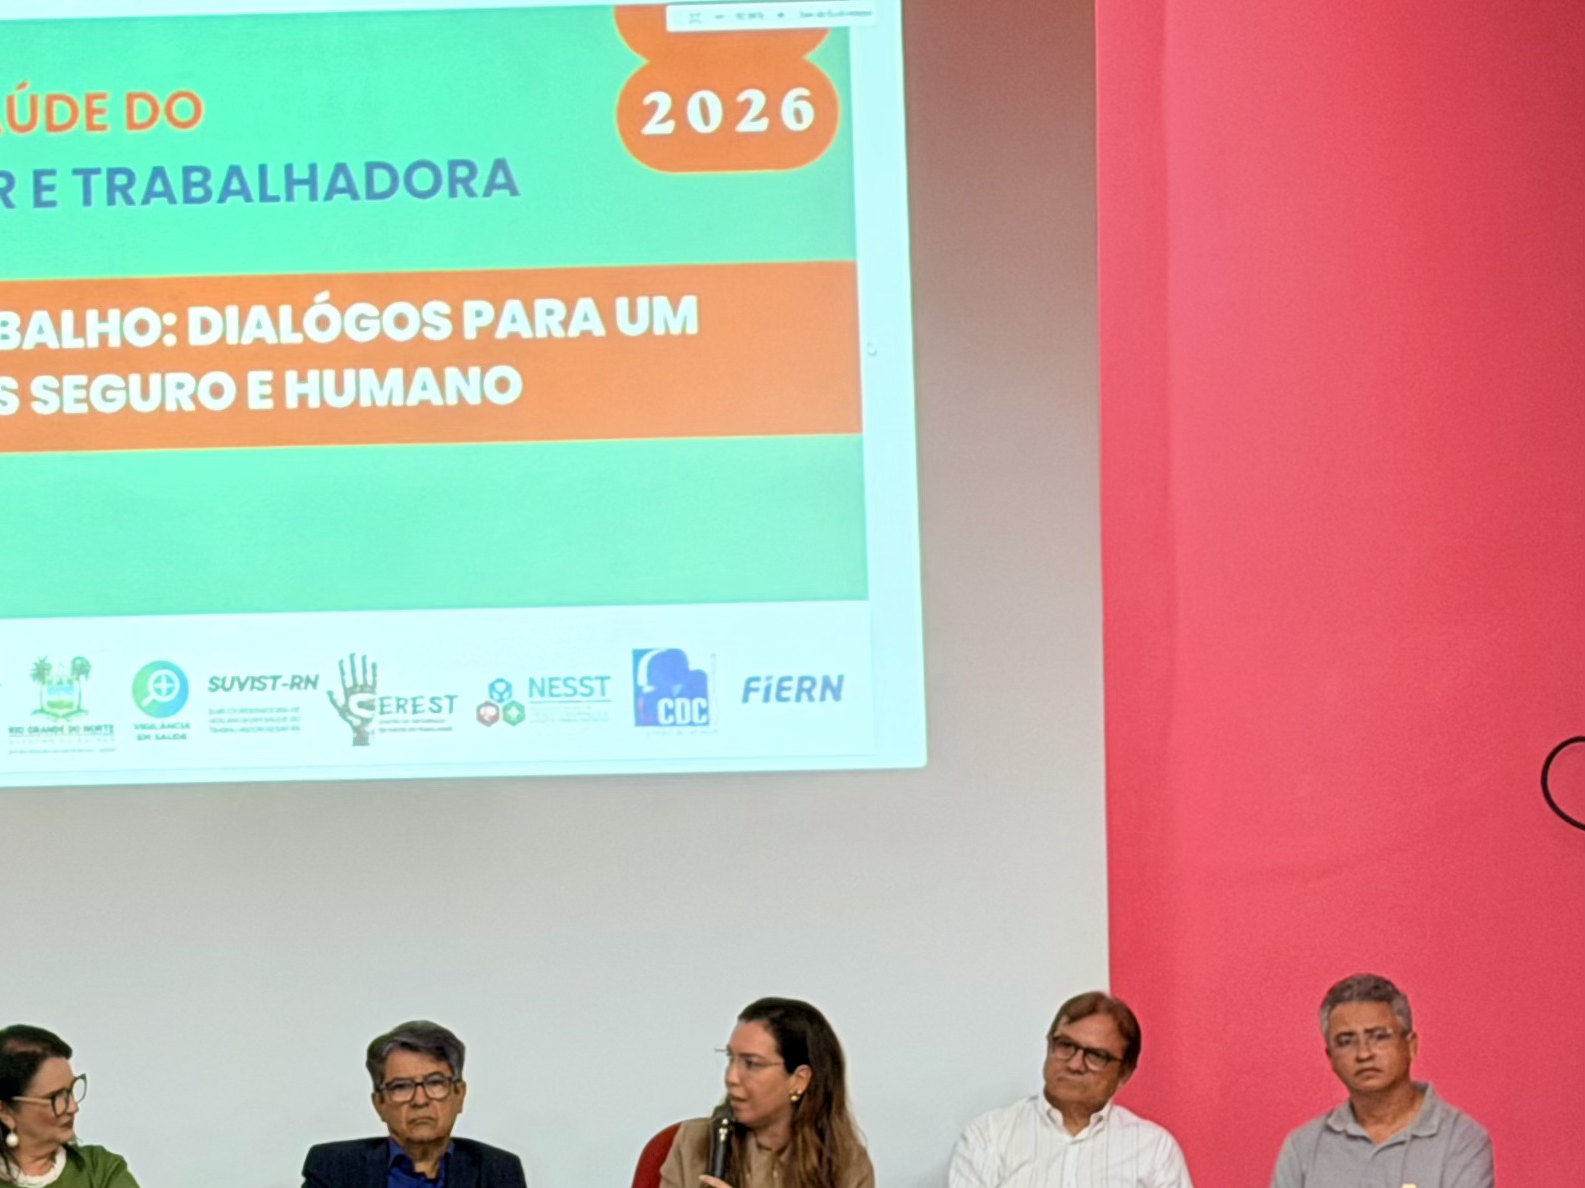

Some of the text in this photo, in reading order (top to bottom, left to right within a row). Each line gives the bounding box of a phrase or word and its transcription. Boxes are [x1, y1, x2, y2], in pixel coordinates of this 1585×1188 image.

[125, 90, 204, 132] DO
[641, 87, 815, 135] 2026
[33, 169, 57, 209] E
[71, 158, 520, 207] TRABALHADORA
[187, 291, 453, 346] DIALÓGOS
[463, 297, 606, 340] PARA
[615, 295, 698, 337] UM
[30, 371, 237, 415] SEGURO
[247, 370, 274, 410] E
[284, 365, 523, 409] HUMANO
[208, 674, 319, 692] SUVIST-RN
[529, 675, 611, 698] NESST
[657, 698, 710, 725] CDC
